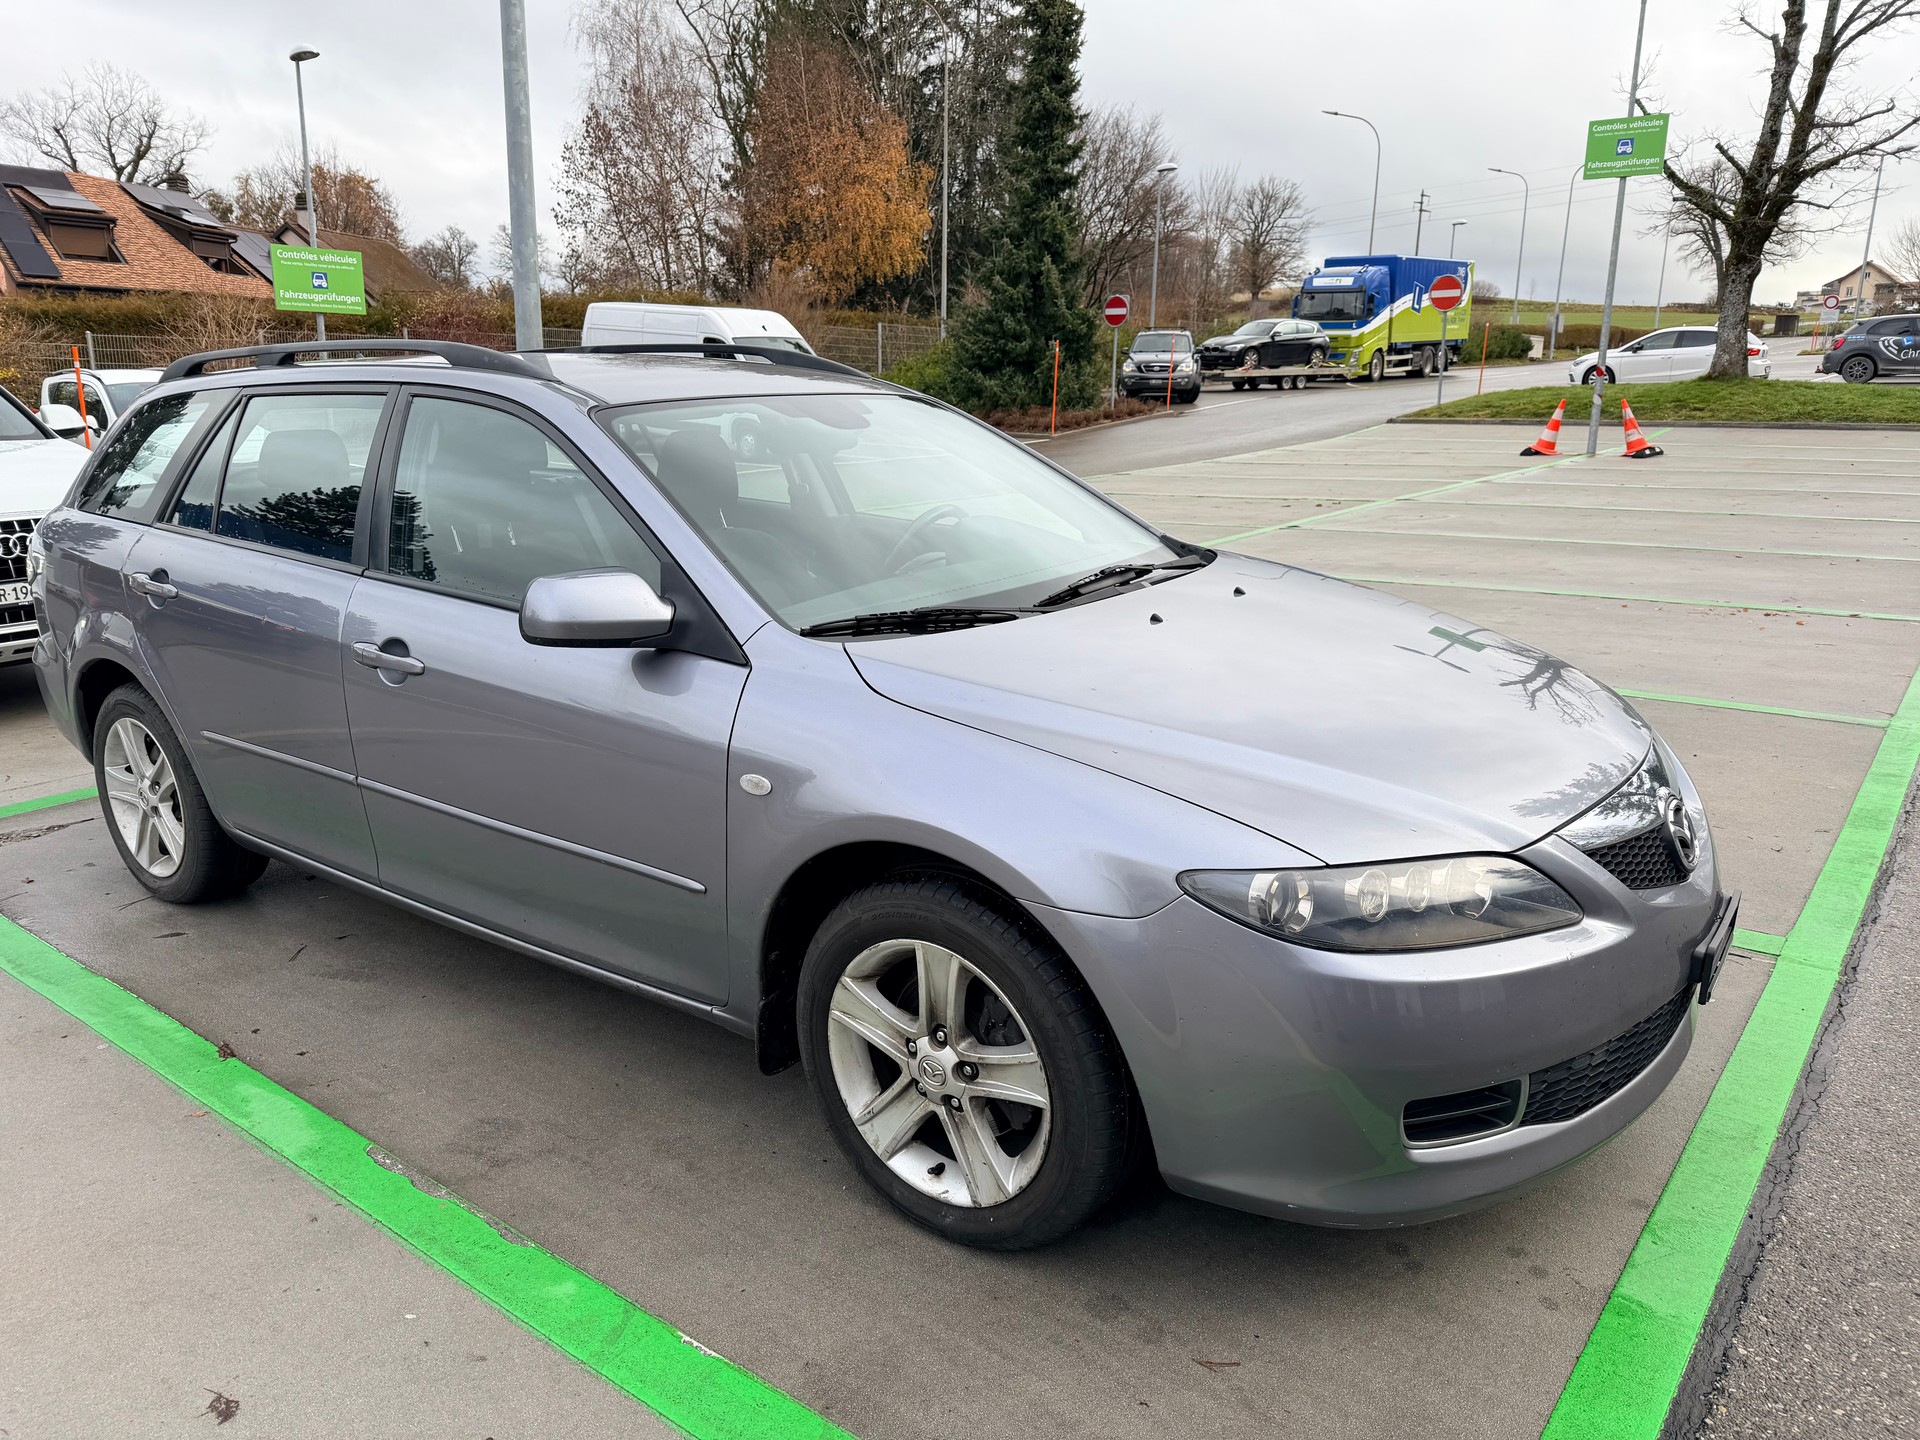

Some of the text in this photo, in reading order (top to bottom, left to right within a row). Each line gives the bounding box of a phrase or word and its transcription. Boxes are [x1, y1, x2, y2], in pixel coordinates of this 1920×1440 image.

[1592, 119, 1664, 132] Contrôles véhicules
[1587, 157, 1660, 169] Fahrzeugprüfungen
[276, 249, 357, 264] Contrôles véhicules
[279, 289, 361, 304] Fahrzeugprüfungen
[1413, 286, 1420, 309] L
